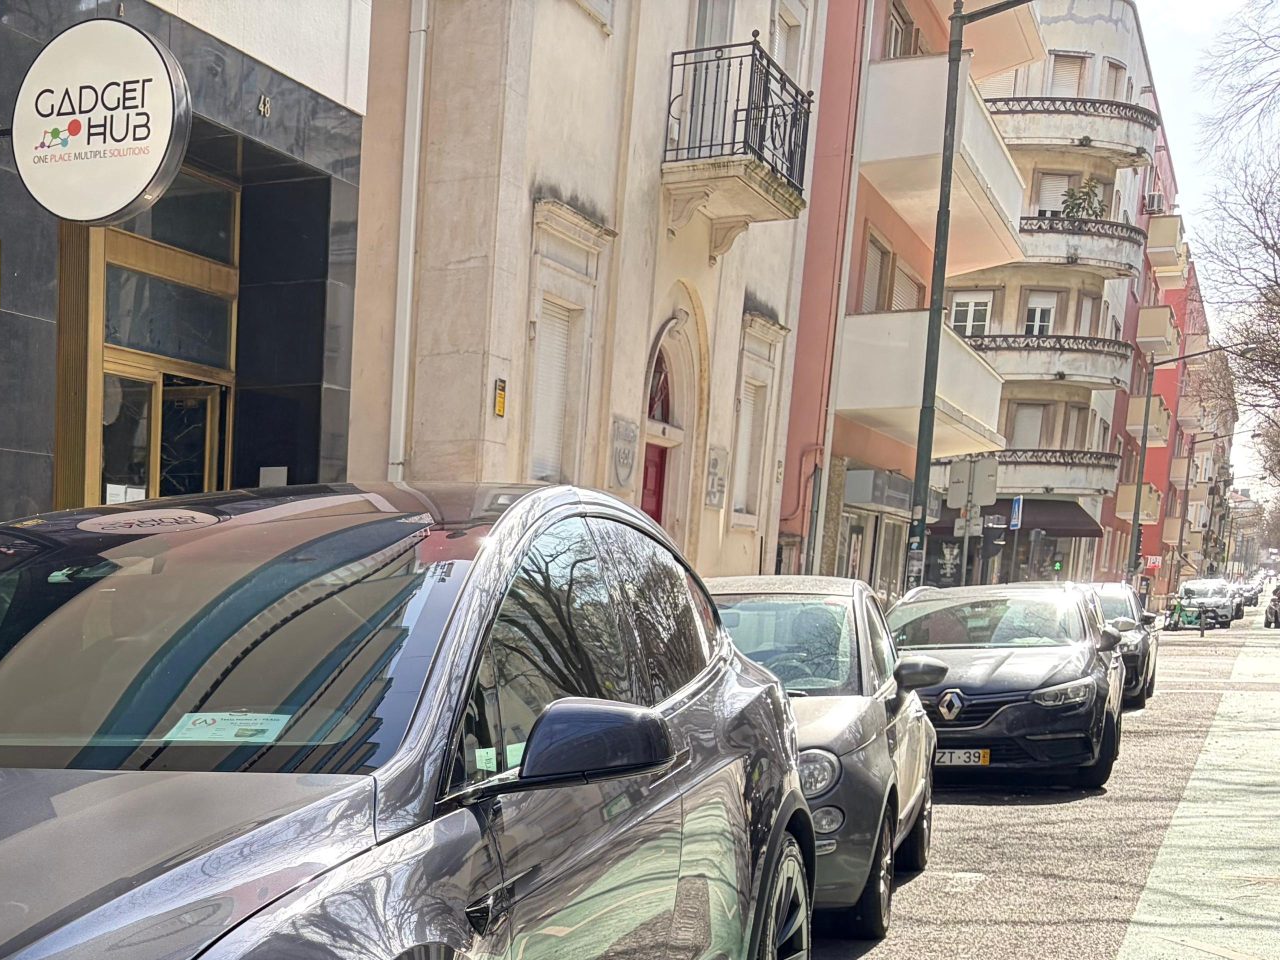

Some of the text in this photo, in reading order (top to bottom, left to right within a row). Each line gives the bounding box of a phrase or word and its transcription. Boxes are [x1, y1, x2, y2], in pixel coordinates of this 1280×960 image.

[34, 78, 153, 118] GADGET
[258, 94, 271, 117] 48
[86, 112, 151, 145] HUB
[33, 145, 150, 164] ONE PLACE MULTIPLE SOLUTIONS
